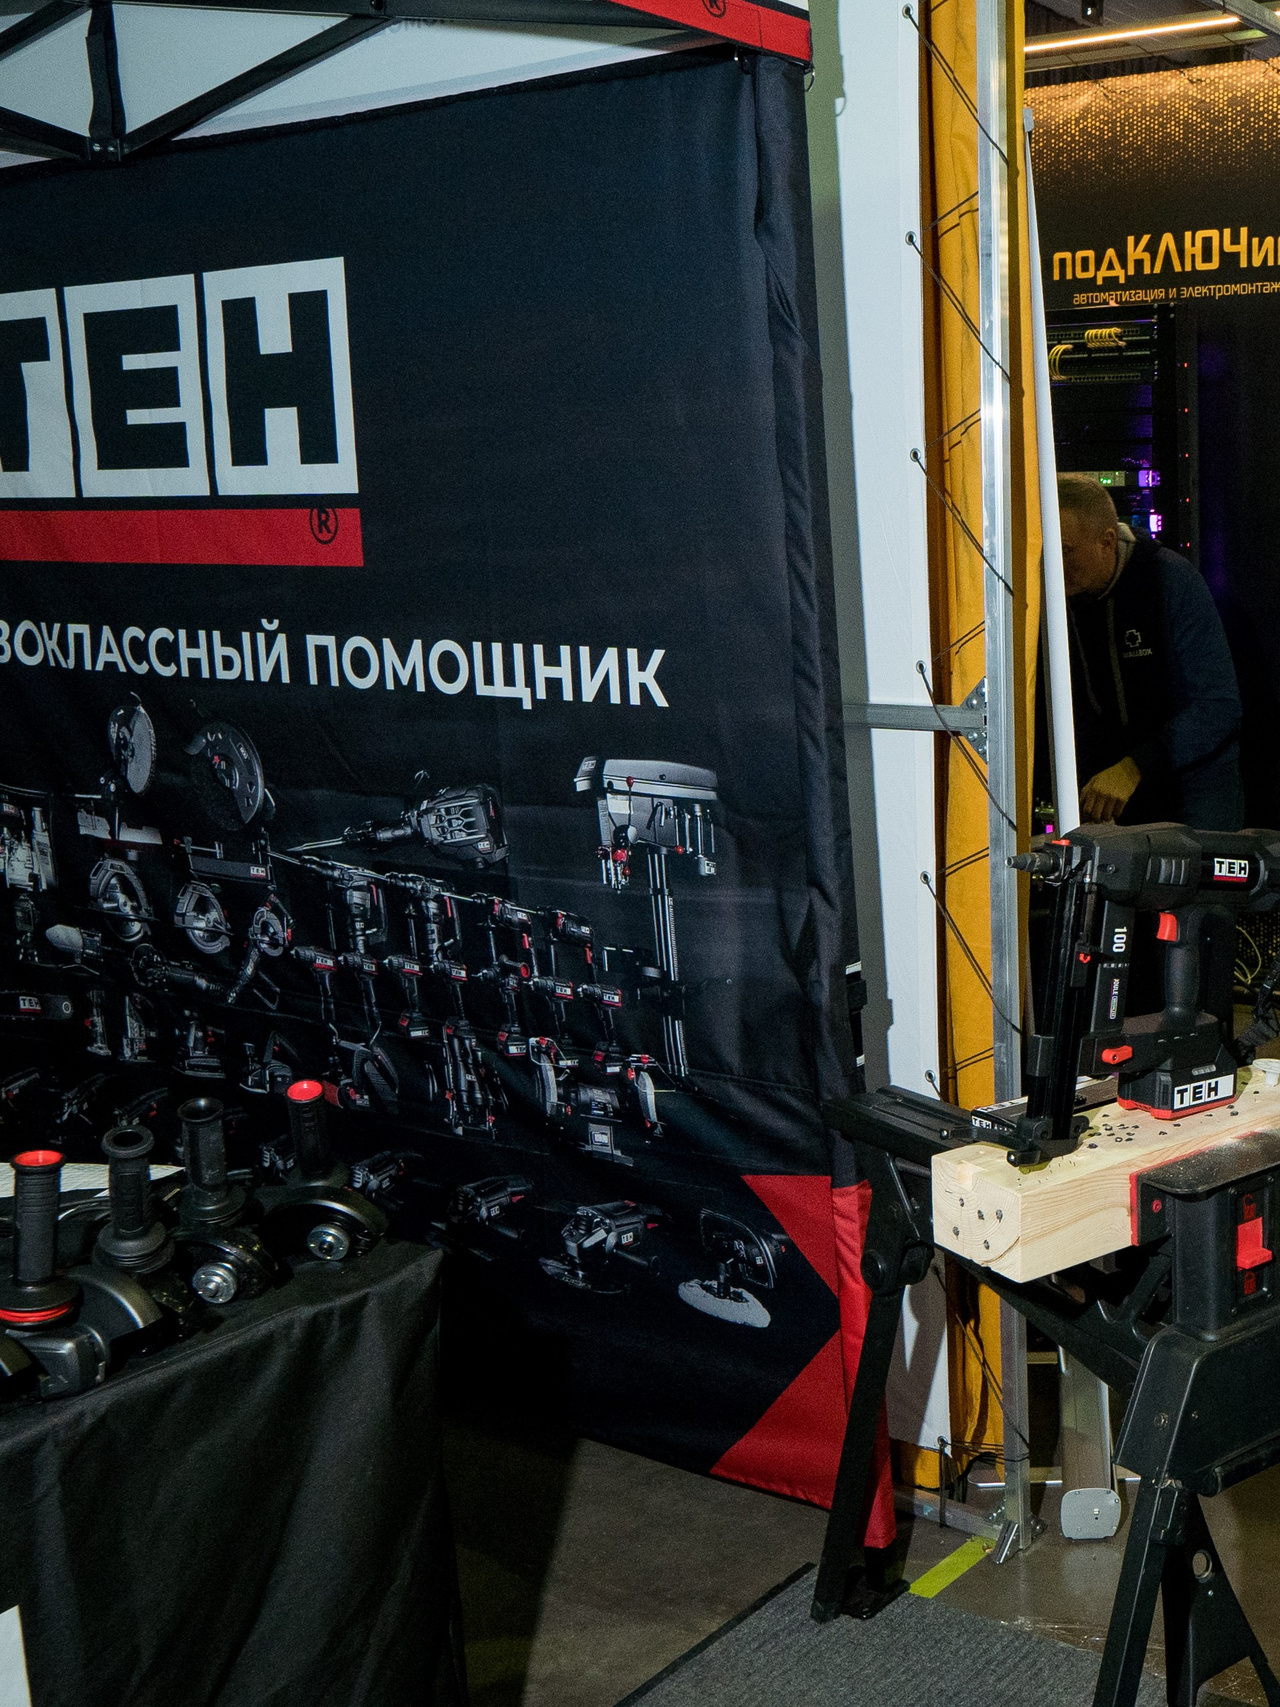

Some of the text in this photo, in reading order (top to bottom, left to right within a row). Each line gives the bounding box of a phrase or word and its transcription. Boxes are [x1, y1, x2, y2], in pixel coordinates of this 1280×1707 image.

[1073, 287, 1165, 305] автоматизация
[1169, 290, 1176, 298] и
[306, 634, 669, 710] ПОМОЩНИК
[1113, 926, 1127, 952] 100
